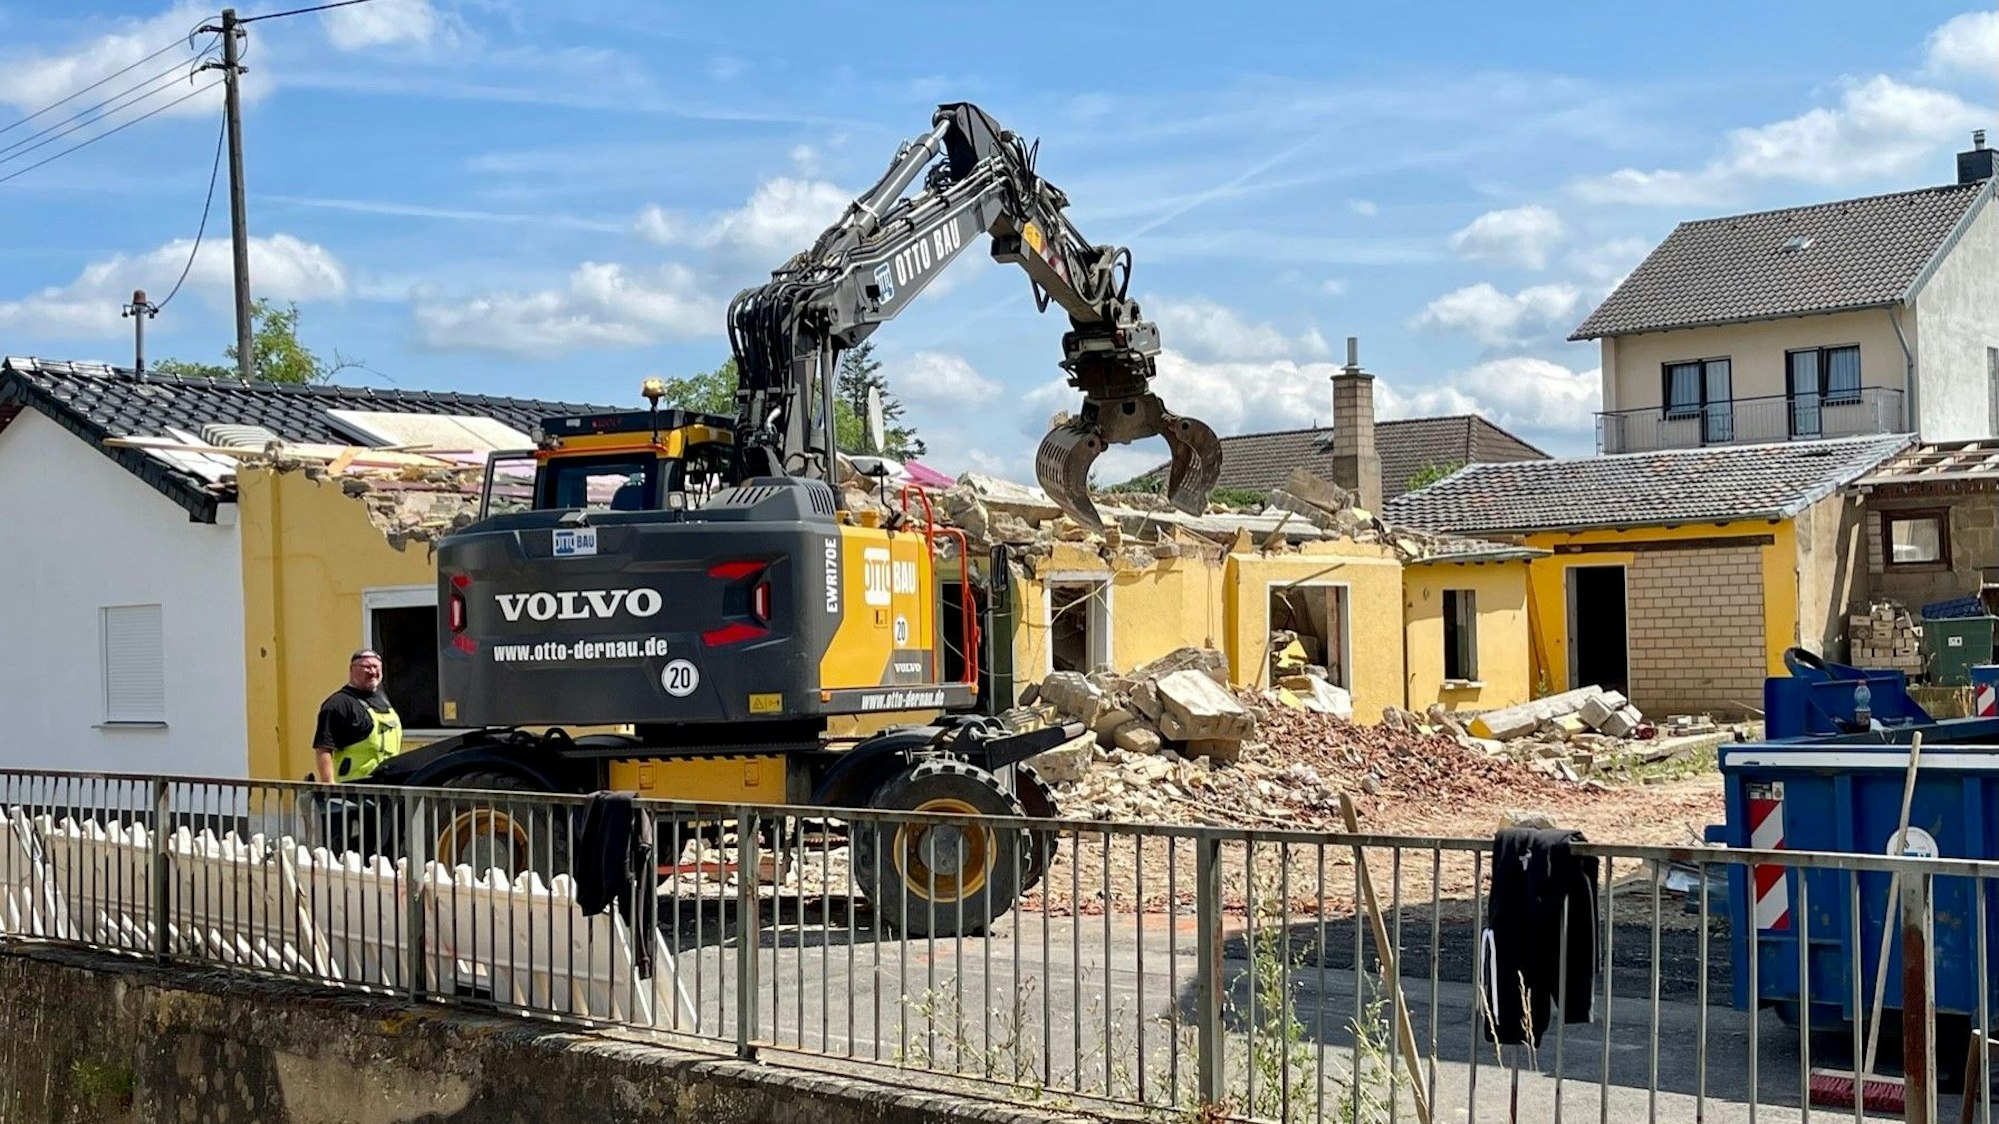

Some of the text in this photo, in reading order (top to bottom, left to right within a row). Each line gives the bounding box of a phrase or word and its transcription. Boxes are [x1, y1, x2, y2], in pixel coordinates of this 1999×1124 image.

[895, 217, 961, 286] OTTO BAU
[576, 534, 595, 548] BAU
[824, 538, 838, 613] EWR170E
[864, 558, 917, 594] OTTO BAU
[494, 587, 663, 622] VOLVO
[896, 620, 906, 641] 20
[493, 636, 668, 661] www.otto-dernau.de
[669, 667, 691, 689] 20
[894, 662, 922, 673] VOLVO
[861, 689, 945, 710] www.otto-dernau.de
